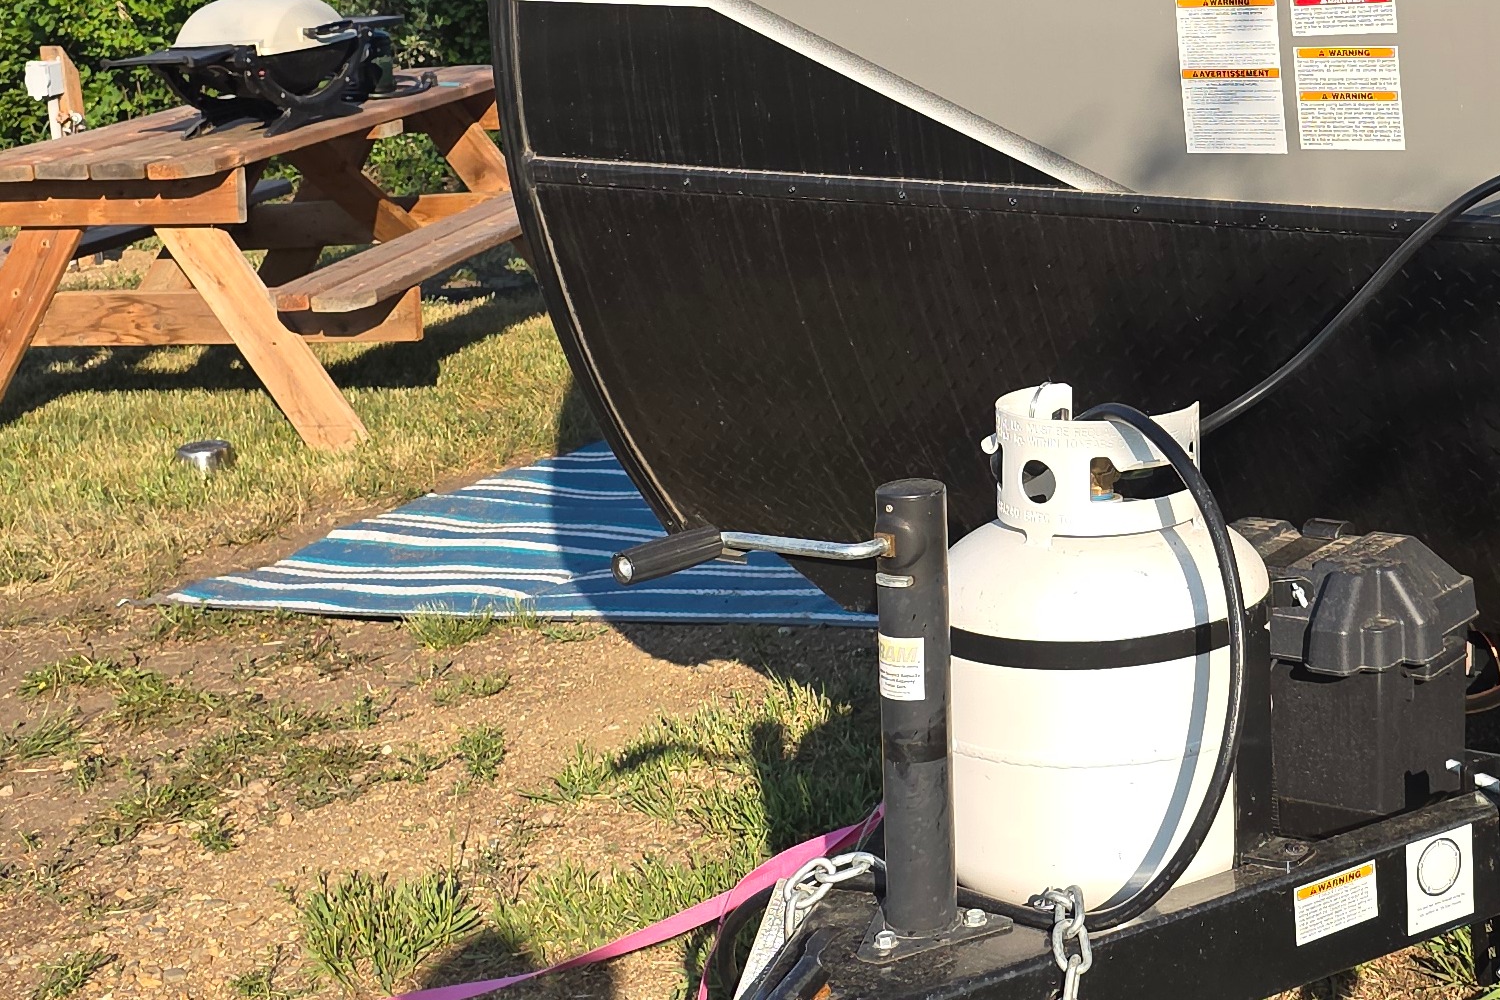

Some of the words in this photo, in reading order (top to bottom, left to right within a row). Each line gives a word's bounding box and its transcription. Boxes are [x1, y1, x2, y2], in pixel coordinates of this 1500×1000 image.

[1329, 49, 1371, 57] WARNING
[1199, 69, 1270, 78] AVERTISSEMENT
[1331, 92, 1374, 100] WARNING
[1317, 870, 1362, 892] WARNING
